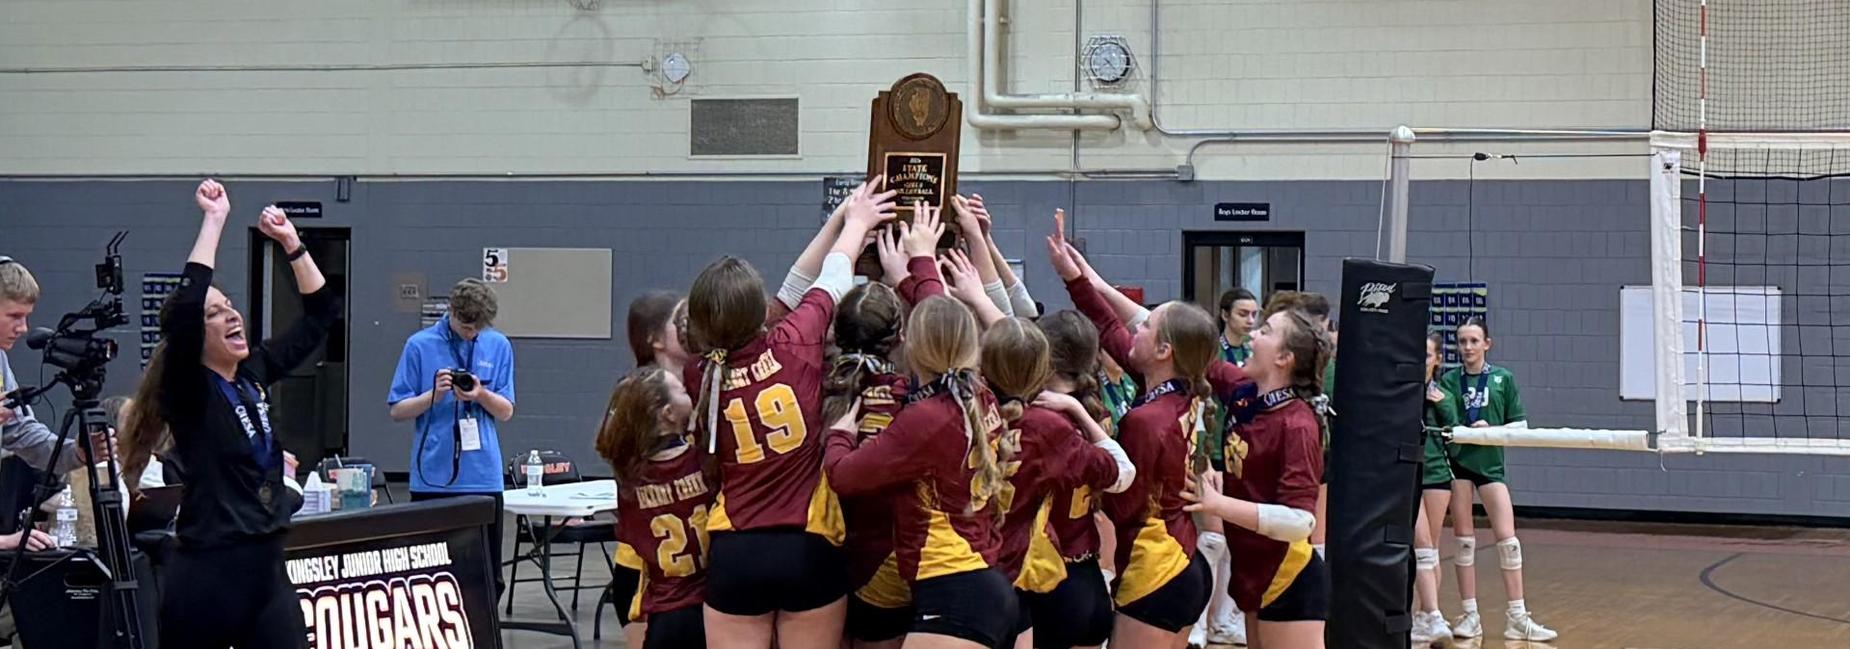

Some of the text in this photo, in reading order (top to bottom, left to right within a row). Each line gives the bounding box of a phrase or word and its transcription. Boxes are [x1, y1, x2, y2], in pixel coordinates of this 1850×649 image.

[902, 164, 927, 172] STATE
[723, 383, 807, 464] 19
[285, 541, 452, 584] KINGSLEY JUNIOR HIGH SCHOOL
